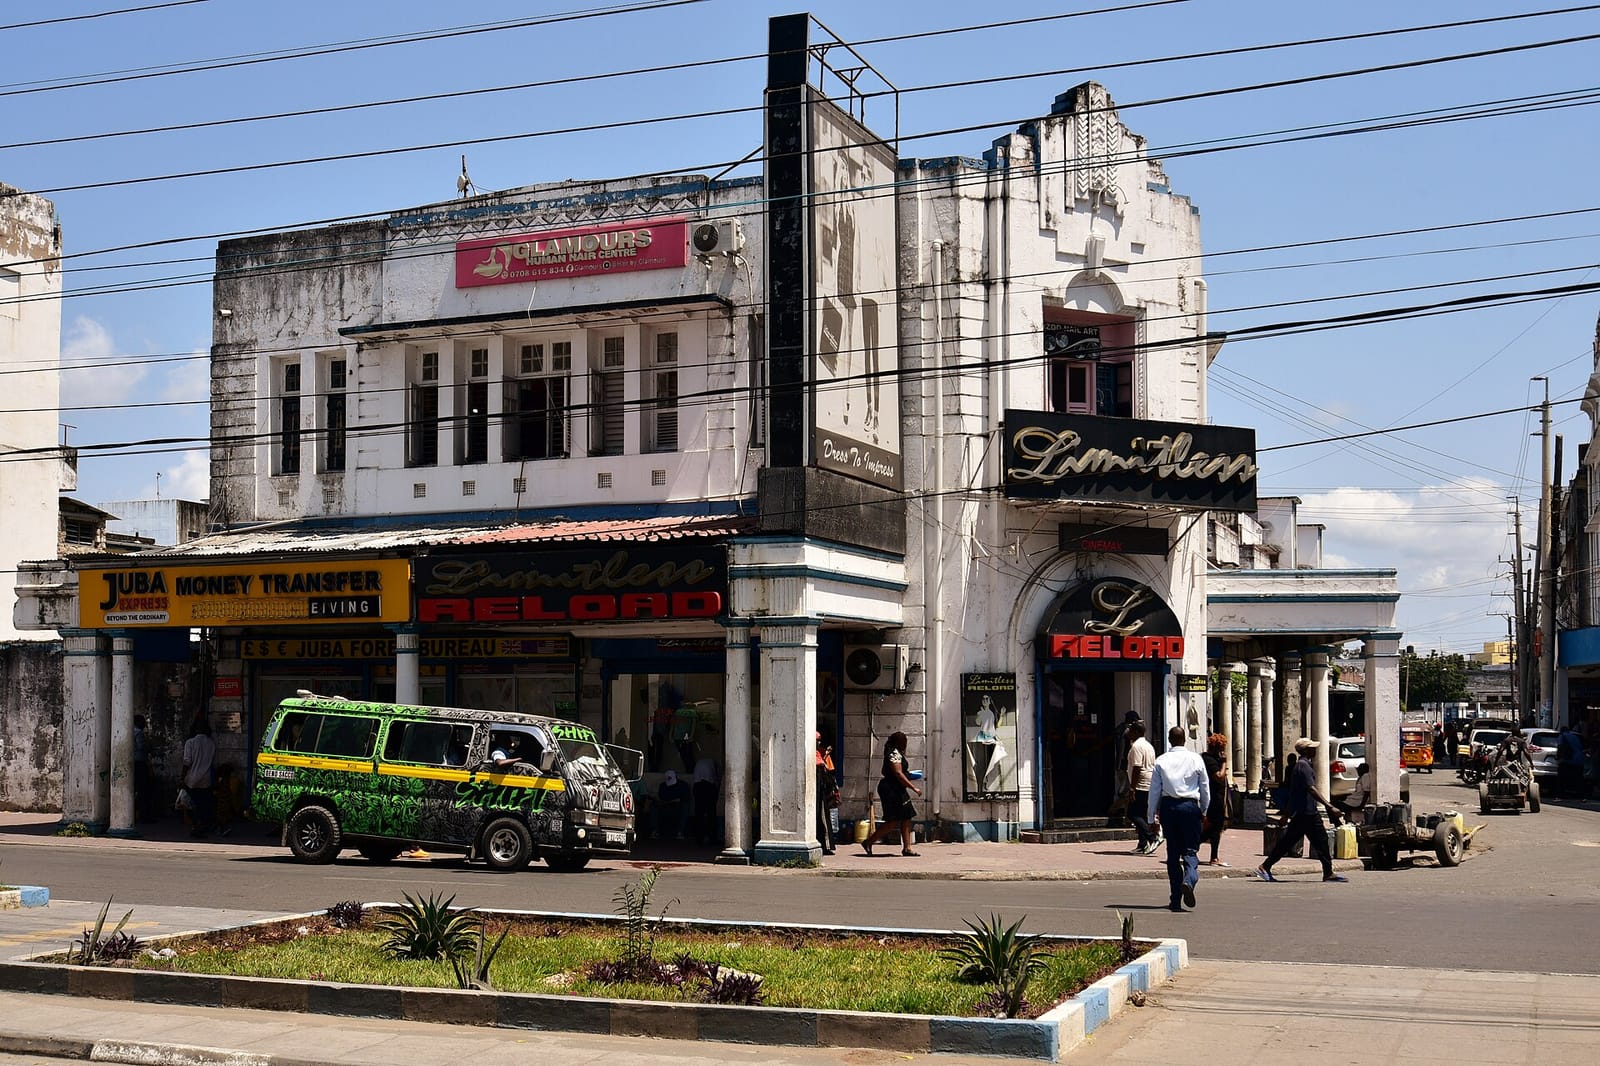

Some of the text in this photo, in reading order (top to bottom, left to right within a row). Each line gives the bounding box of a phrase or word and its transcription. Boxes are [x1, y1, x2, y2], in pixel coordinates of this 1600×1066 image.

[513, 230, 652, 258] GLAMOURS
[526, 247, 637, 266] HUMAN HAIR CENTRE
[549, 266, 564, 274] 834
[1083, 328, 1098, 336] ART
[823, 438, 895, 478] Dress To Impress
[100, 571, 168, 611] JUBA
[175, 570, 383, 597] MONEY TRANSFER
[119, 597, 169, 611] EXPRESS
[417, 590, 724, 622] RELOAD
[139, 613, 167, 621] ORDINARY
[296, 640, 345, 657] JUBA
[419, 639, 496, 657] BUREAU
[1051, 634, 1185, 659] RELOAD
